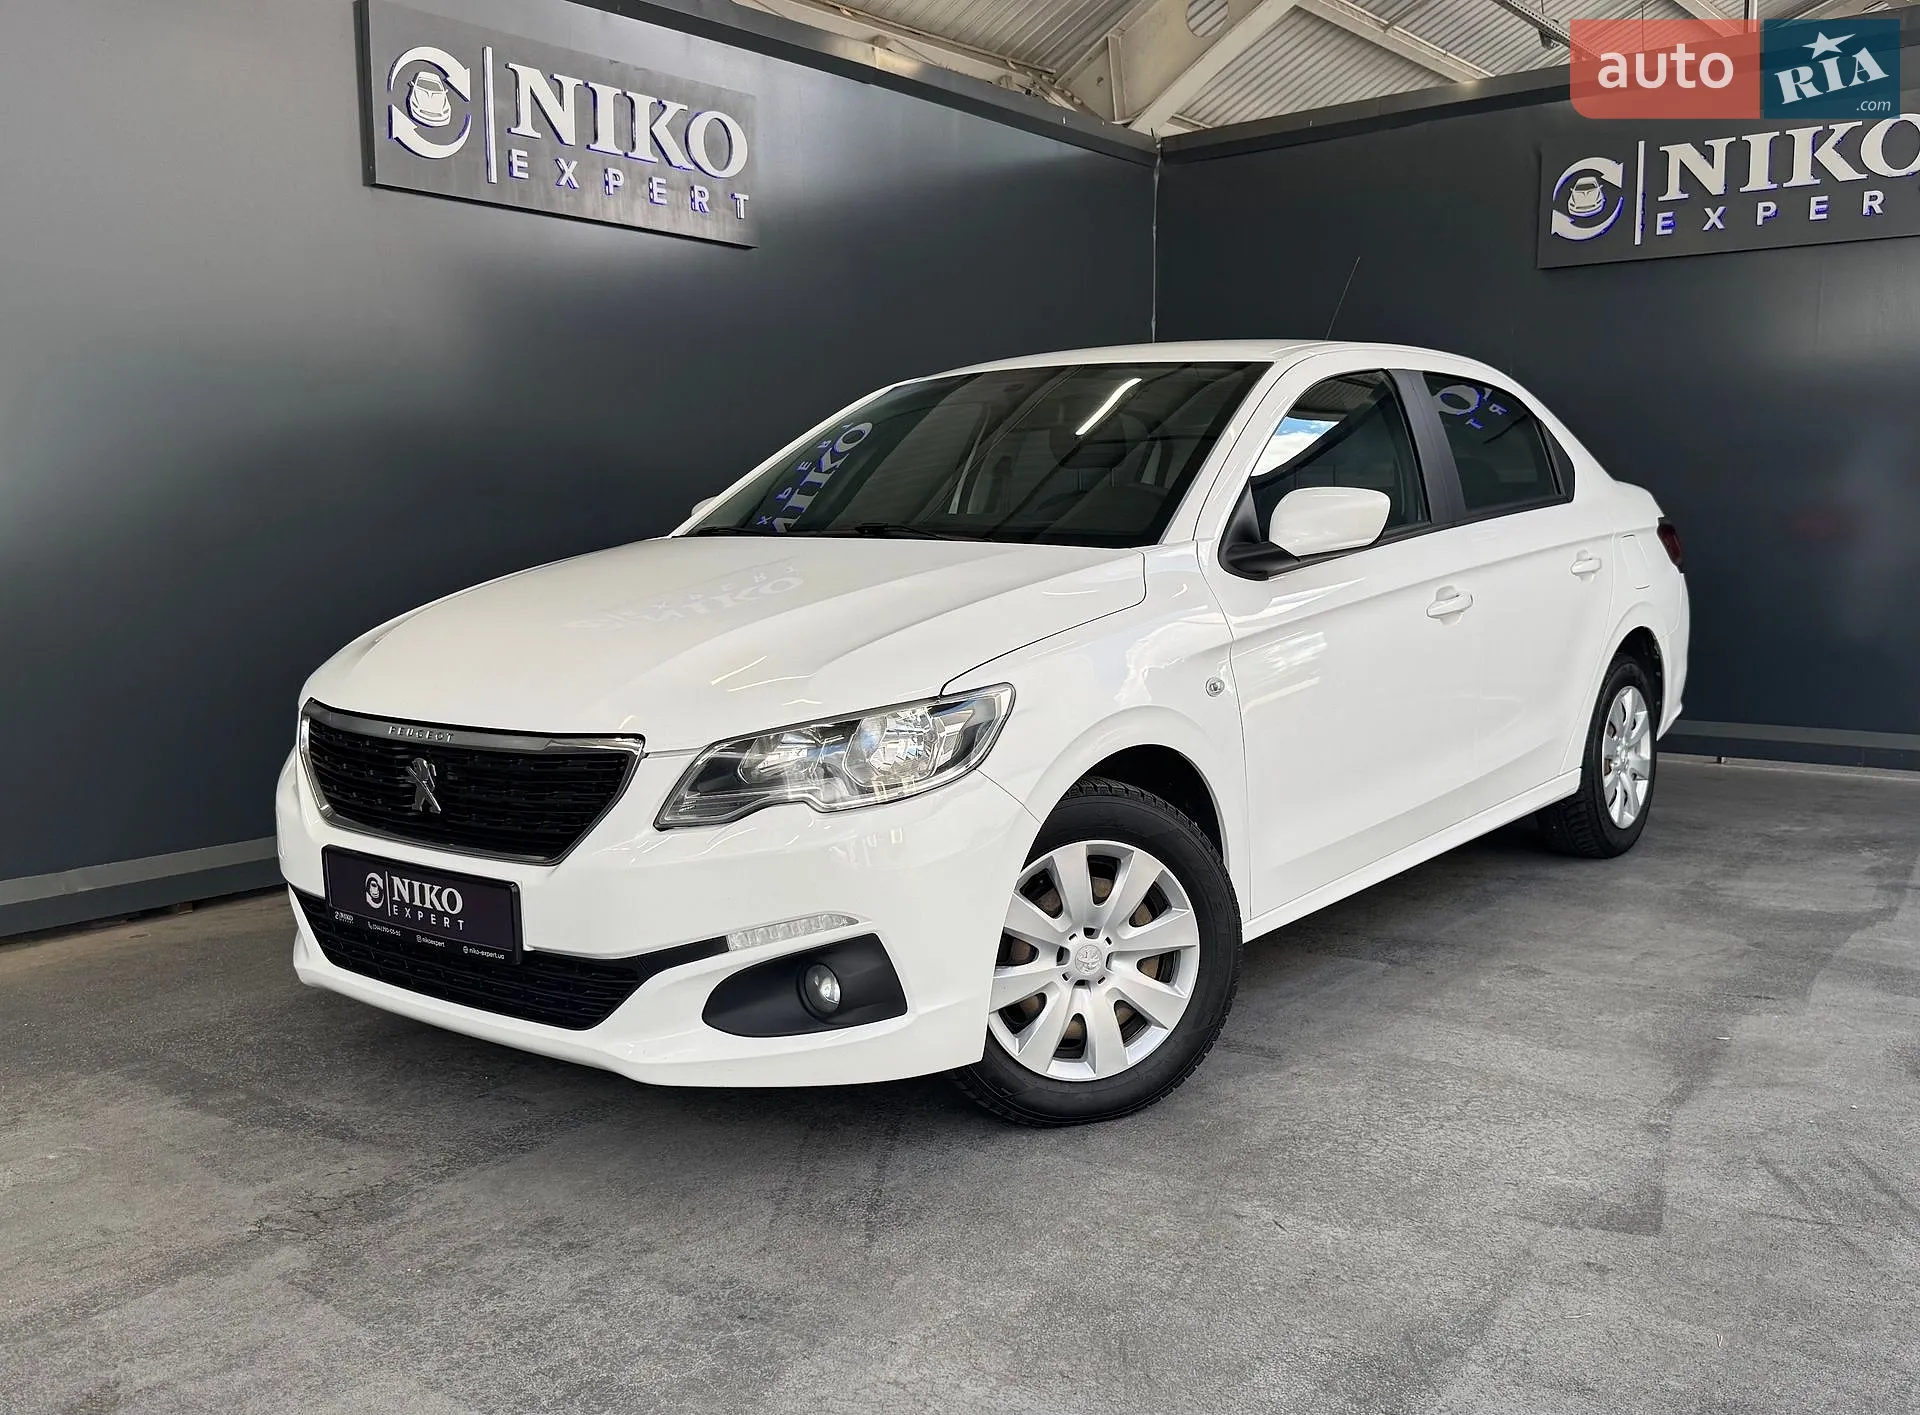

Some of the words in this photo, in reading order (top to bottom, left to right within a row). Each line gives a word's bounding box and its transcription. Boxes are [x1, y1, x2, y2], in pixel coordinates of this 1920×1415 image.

[505, 62, 749, 178] NIKO
[1657, 113, 1920, 202] NIKO
[508, 148, 750, 220] EXPERT
[1655, 190, 1886, 236] EXPER
[388, 725, 454, 743] PEUGEOT
[391, 875, 464, 915] NIKO
[393, 904, 465, 931] EXPERT
